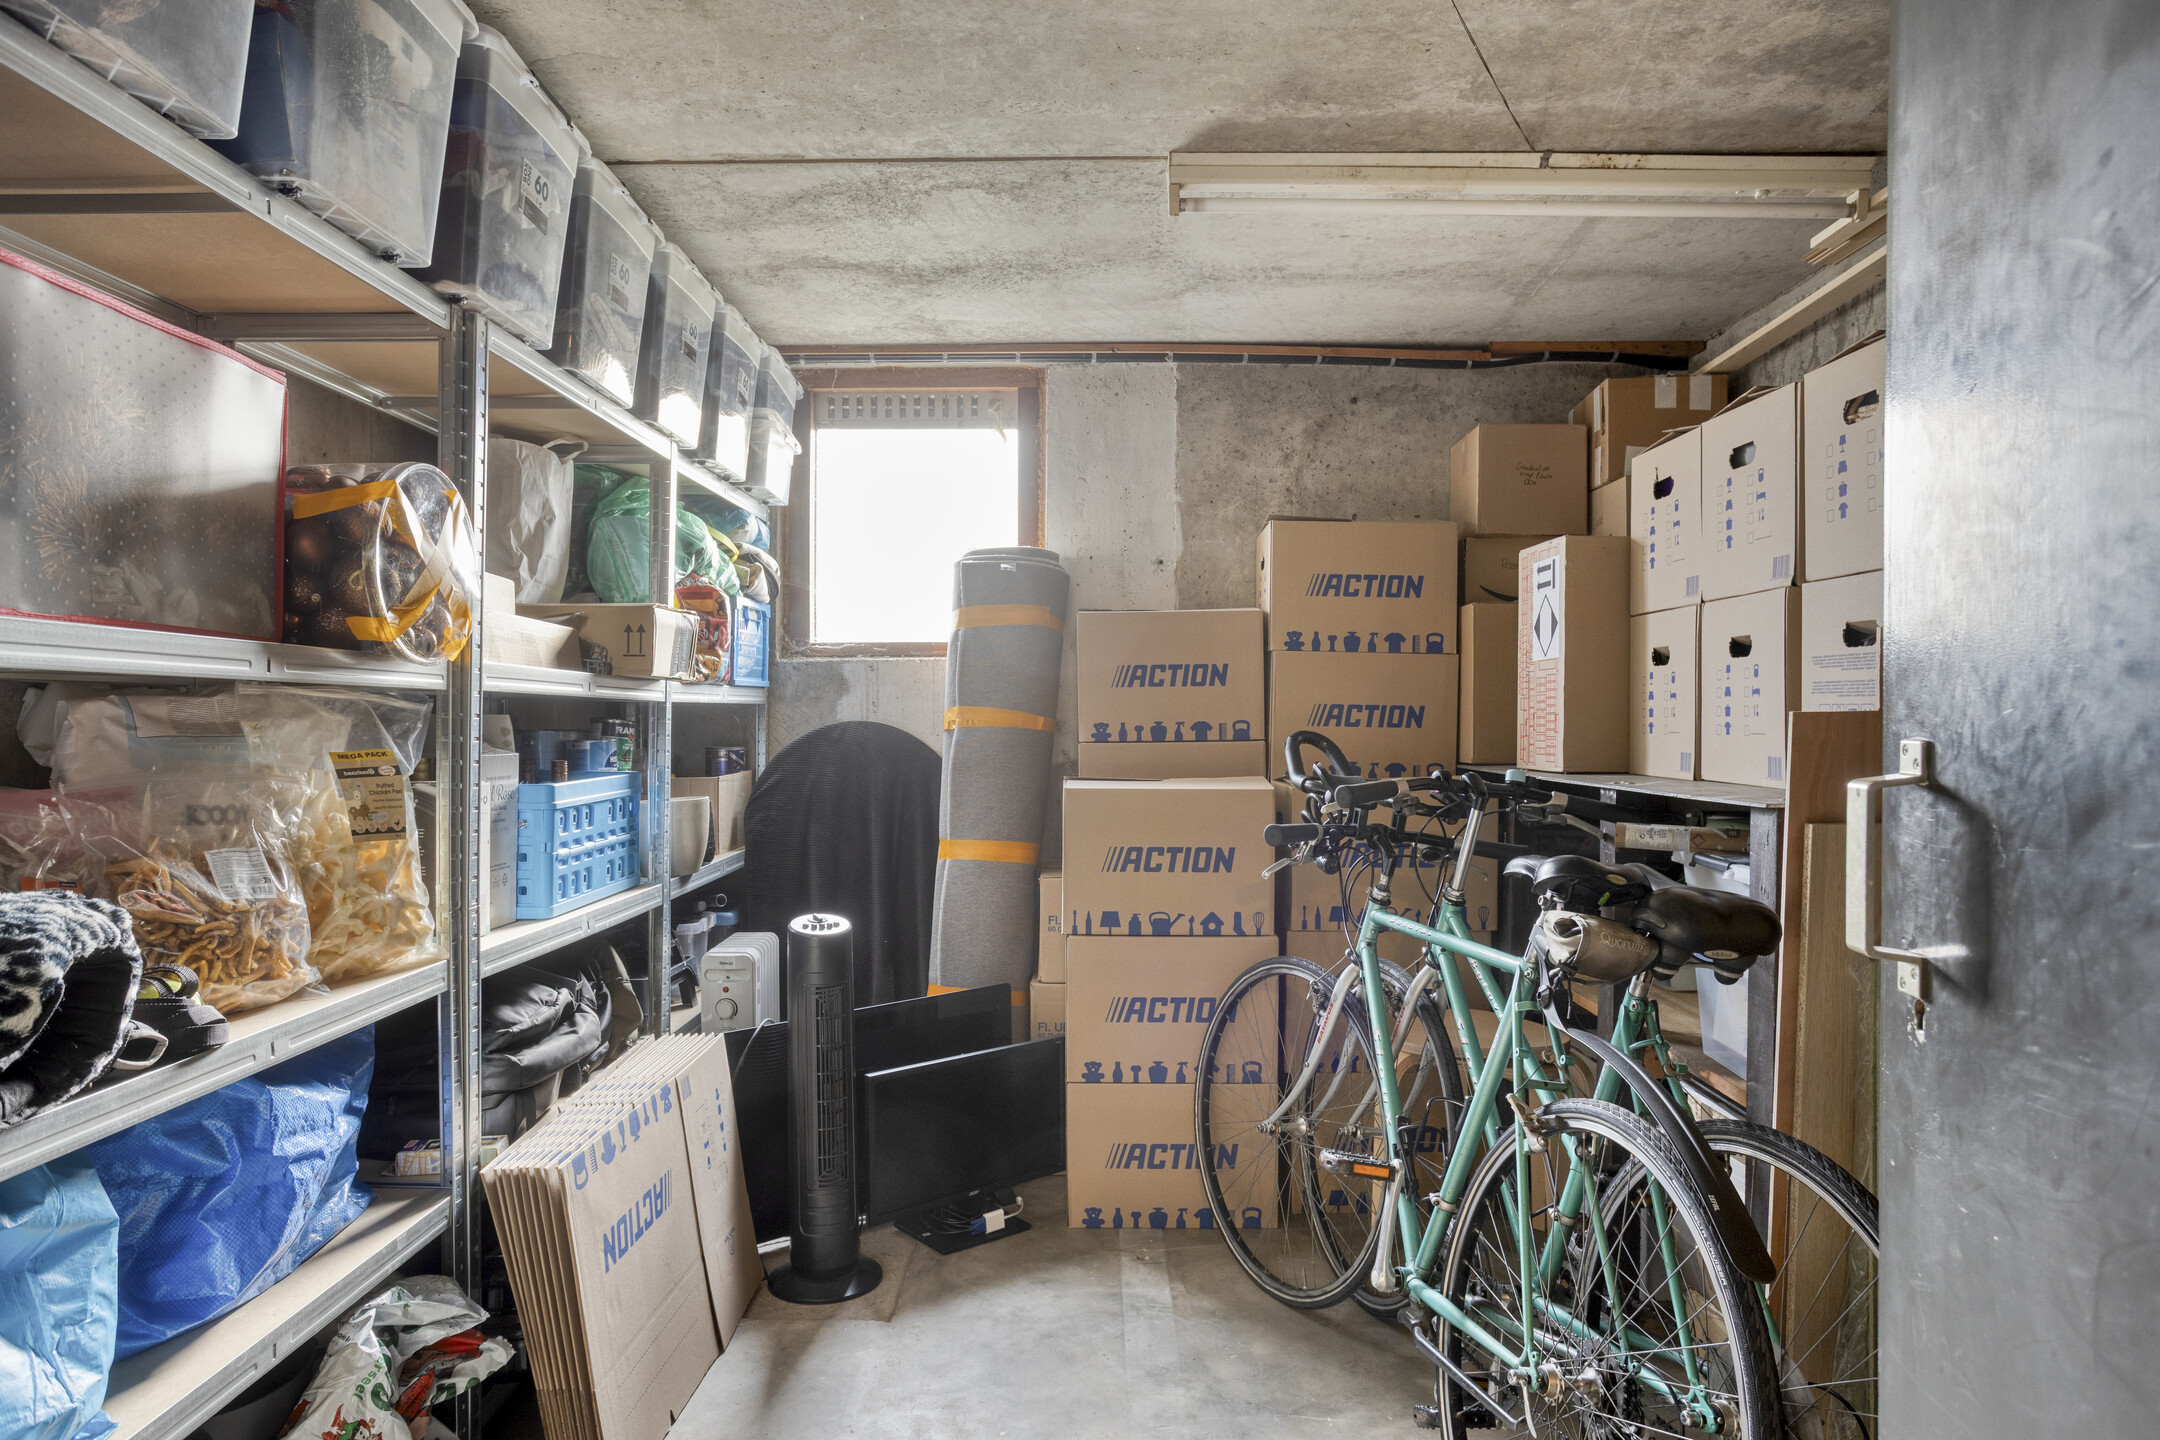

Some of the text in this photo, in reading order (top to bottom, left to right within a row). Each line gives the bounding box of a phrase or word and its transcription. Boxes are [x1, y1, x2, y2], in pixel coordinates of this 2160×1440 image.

[534, 175, 549, 202] 60
[619, 263, 630, 285] 60
[689, 322, 698, 340] 60
[1322, 573, 1425, 599] ACTION
[1127, 663, 1229, 688] ACTION
[1323, 703, 1426, 729] ACTION
[1120, 846, 1236, 873] ACTION
[1600, 931, 1643, 951] Quorum
[1317, 1002, 1334, 1044] BATAVUS
[602, 1175, 665, 1275] ACTION
